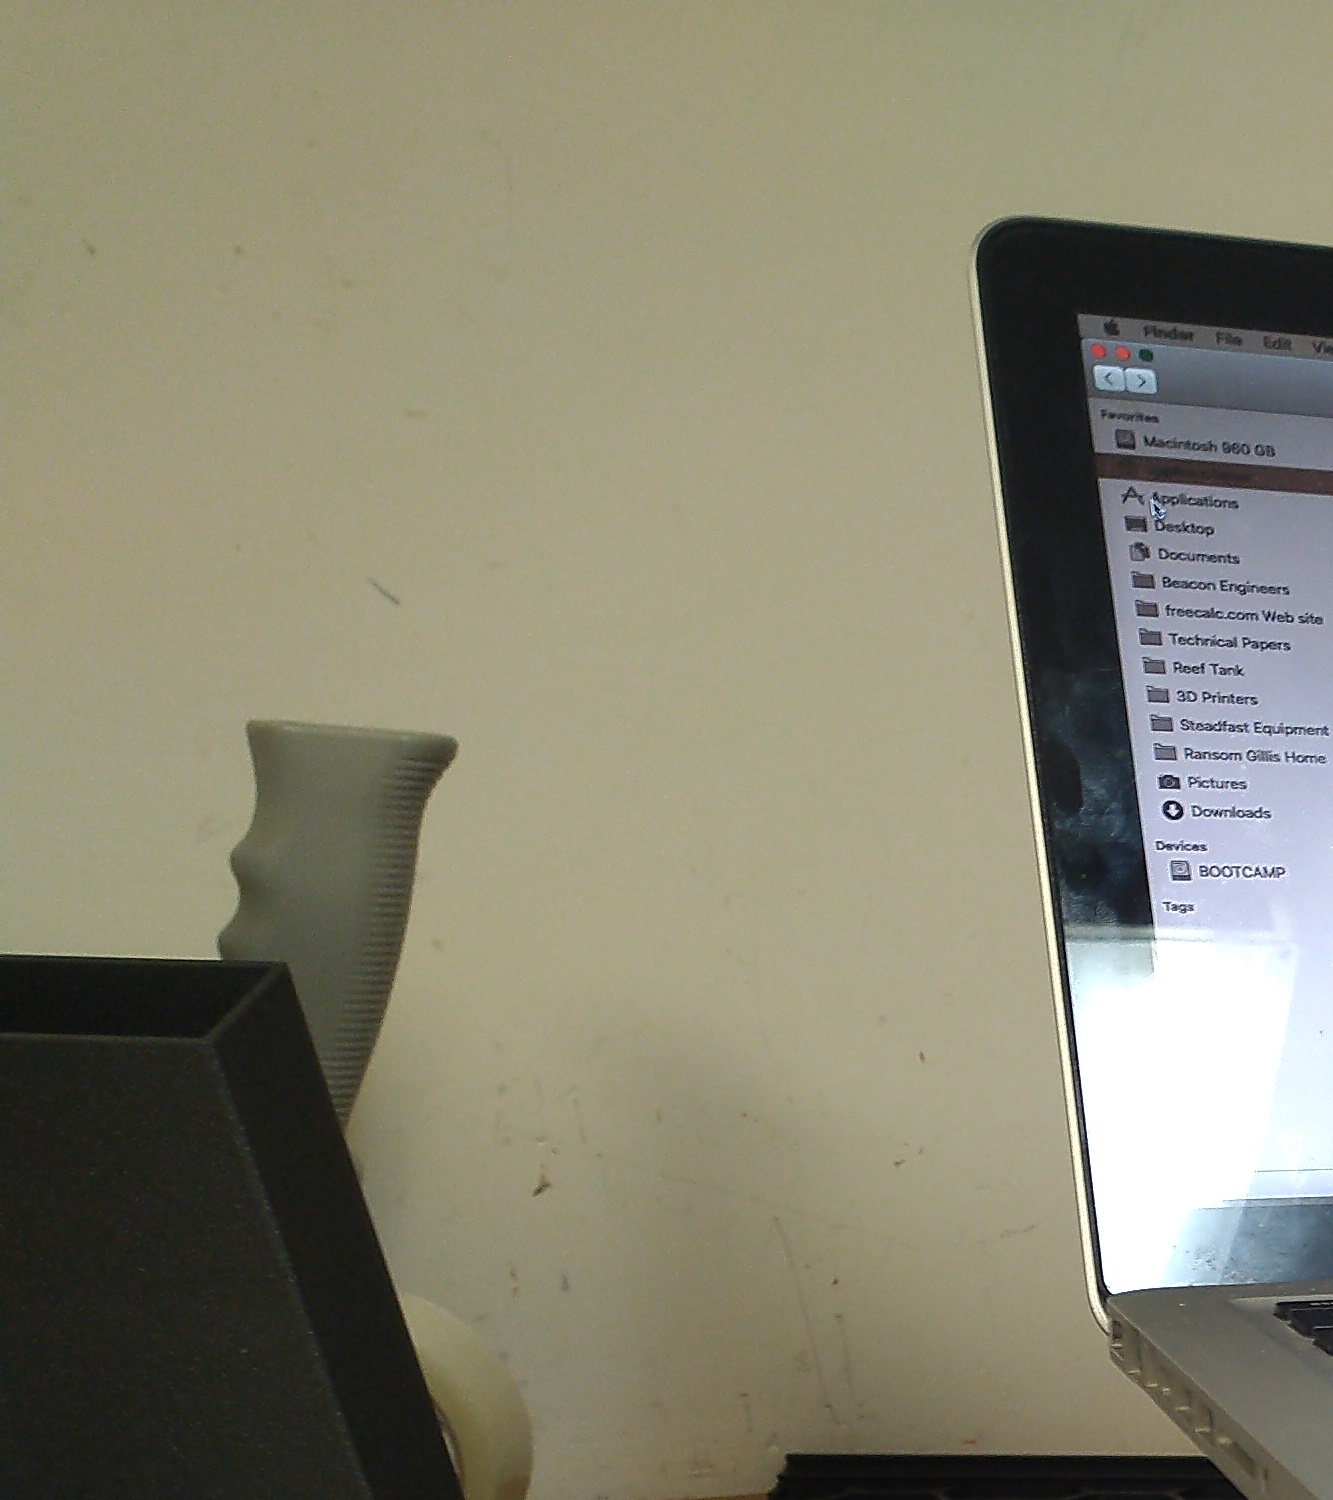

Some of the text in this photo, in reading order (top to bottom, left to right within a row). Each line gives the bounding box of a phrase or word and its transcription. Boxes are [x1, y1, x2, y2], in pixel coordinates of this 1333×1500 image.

[1262, 338, 1292, 350] Edit
[1099, 408, 1160, 424] Favorites
[1142, 436, 1218, 452] Macintosh
[1253, 445, 1276, 457] GB
[1153, 520, 1215, 537] Desktop
[1157, 548, 1240, 564] Documents
[1161, 577, 1290, 597] Beacon Engineers
[1164, 605, 1324, 625] freecalc.com Web site
[1169, 634, 1291, 653] Technical Papers
[1172, 662, 1245, 676] Reef Tank
[1176, 692, 1259, 704] 3D Printers
[1179, 720, 1329, 738] Steadfast Equipment
[1183, 749, 1243, 761] Ransom
[1283, 752, 1327, 763] Home
[1186, 777, 1248, 789] Pictures
[1190, 806, 1272, 818] Downloads
[1154, 840, 1208, 852] Devices
[1198, 865, 1286, 877] BOOTCAMP
[1161, 900, 1195, 915] Tags
